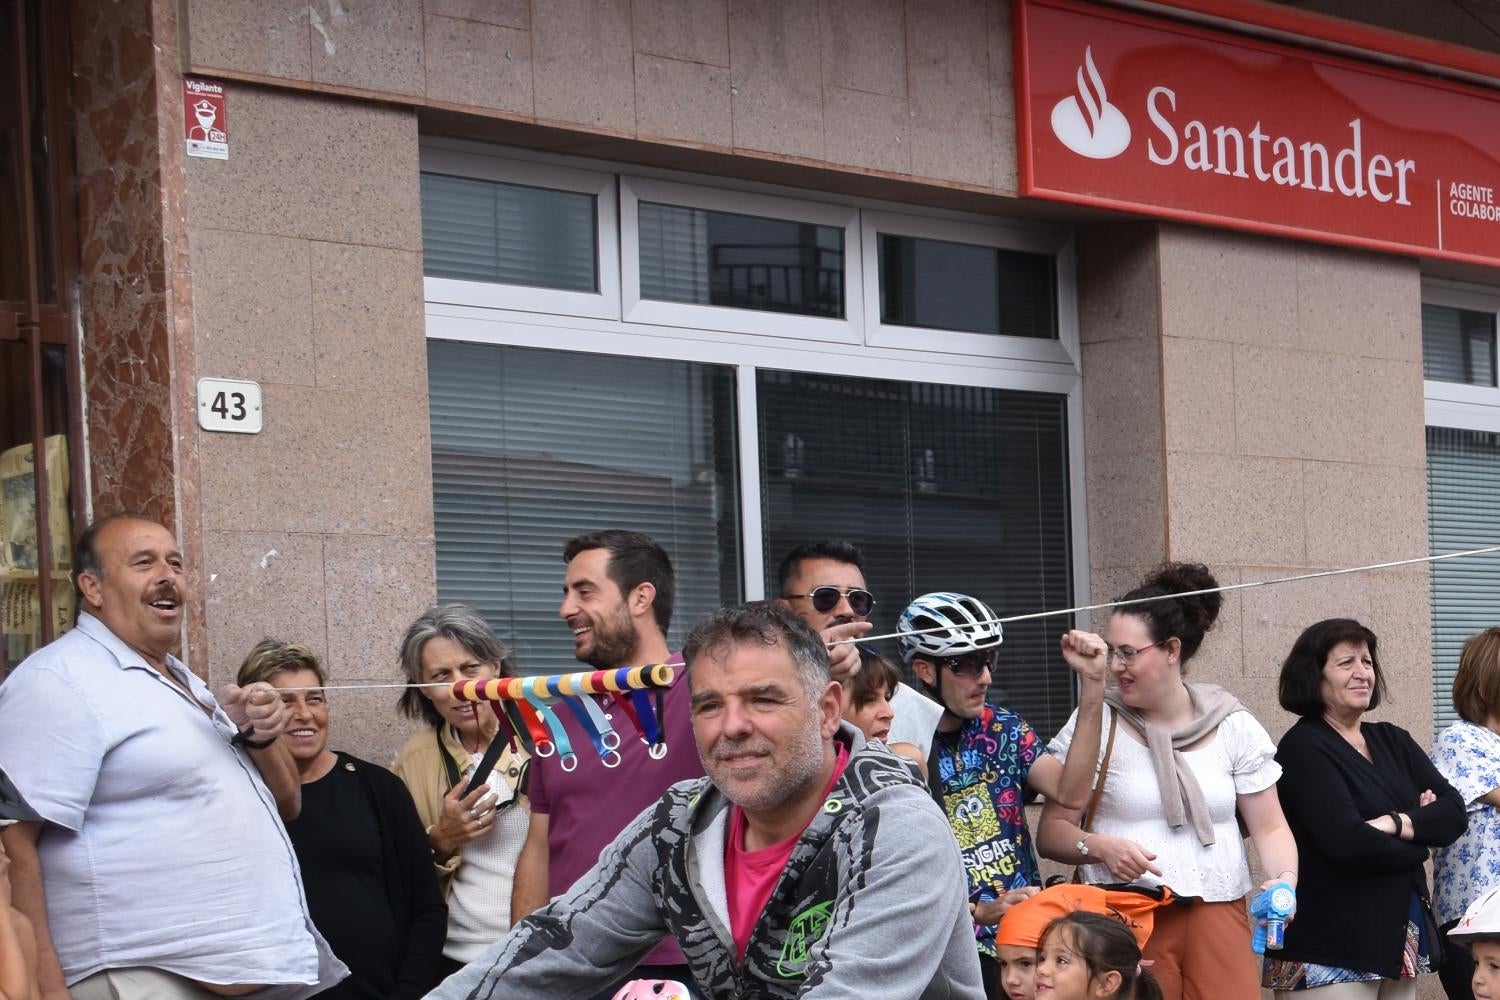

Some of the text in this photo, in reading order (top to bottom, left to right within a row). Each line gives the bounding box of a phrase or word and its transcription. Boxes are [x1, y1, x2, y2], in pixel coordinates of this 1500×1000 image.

[186, 80, 223, 94] Vigilante
[1146, 86, 1416, 206] Santander
[1449, 182, 1494, 204] AGENTE
[210, 391, 247, 422] 43
